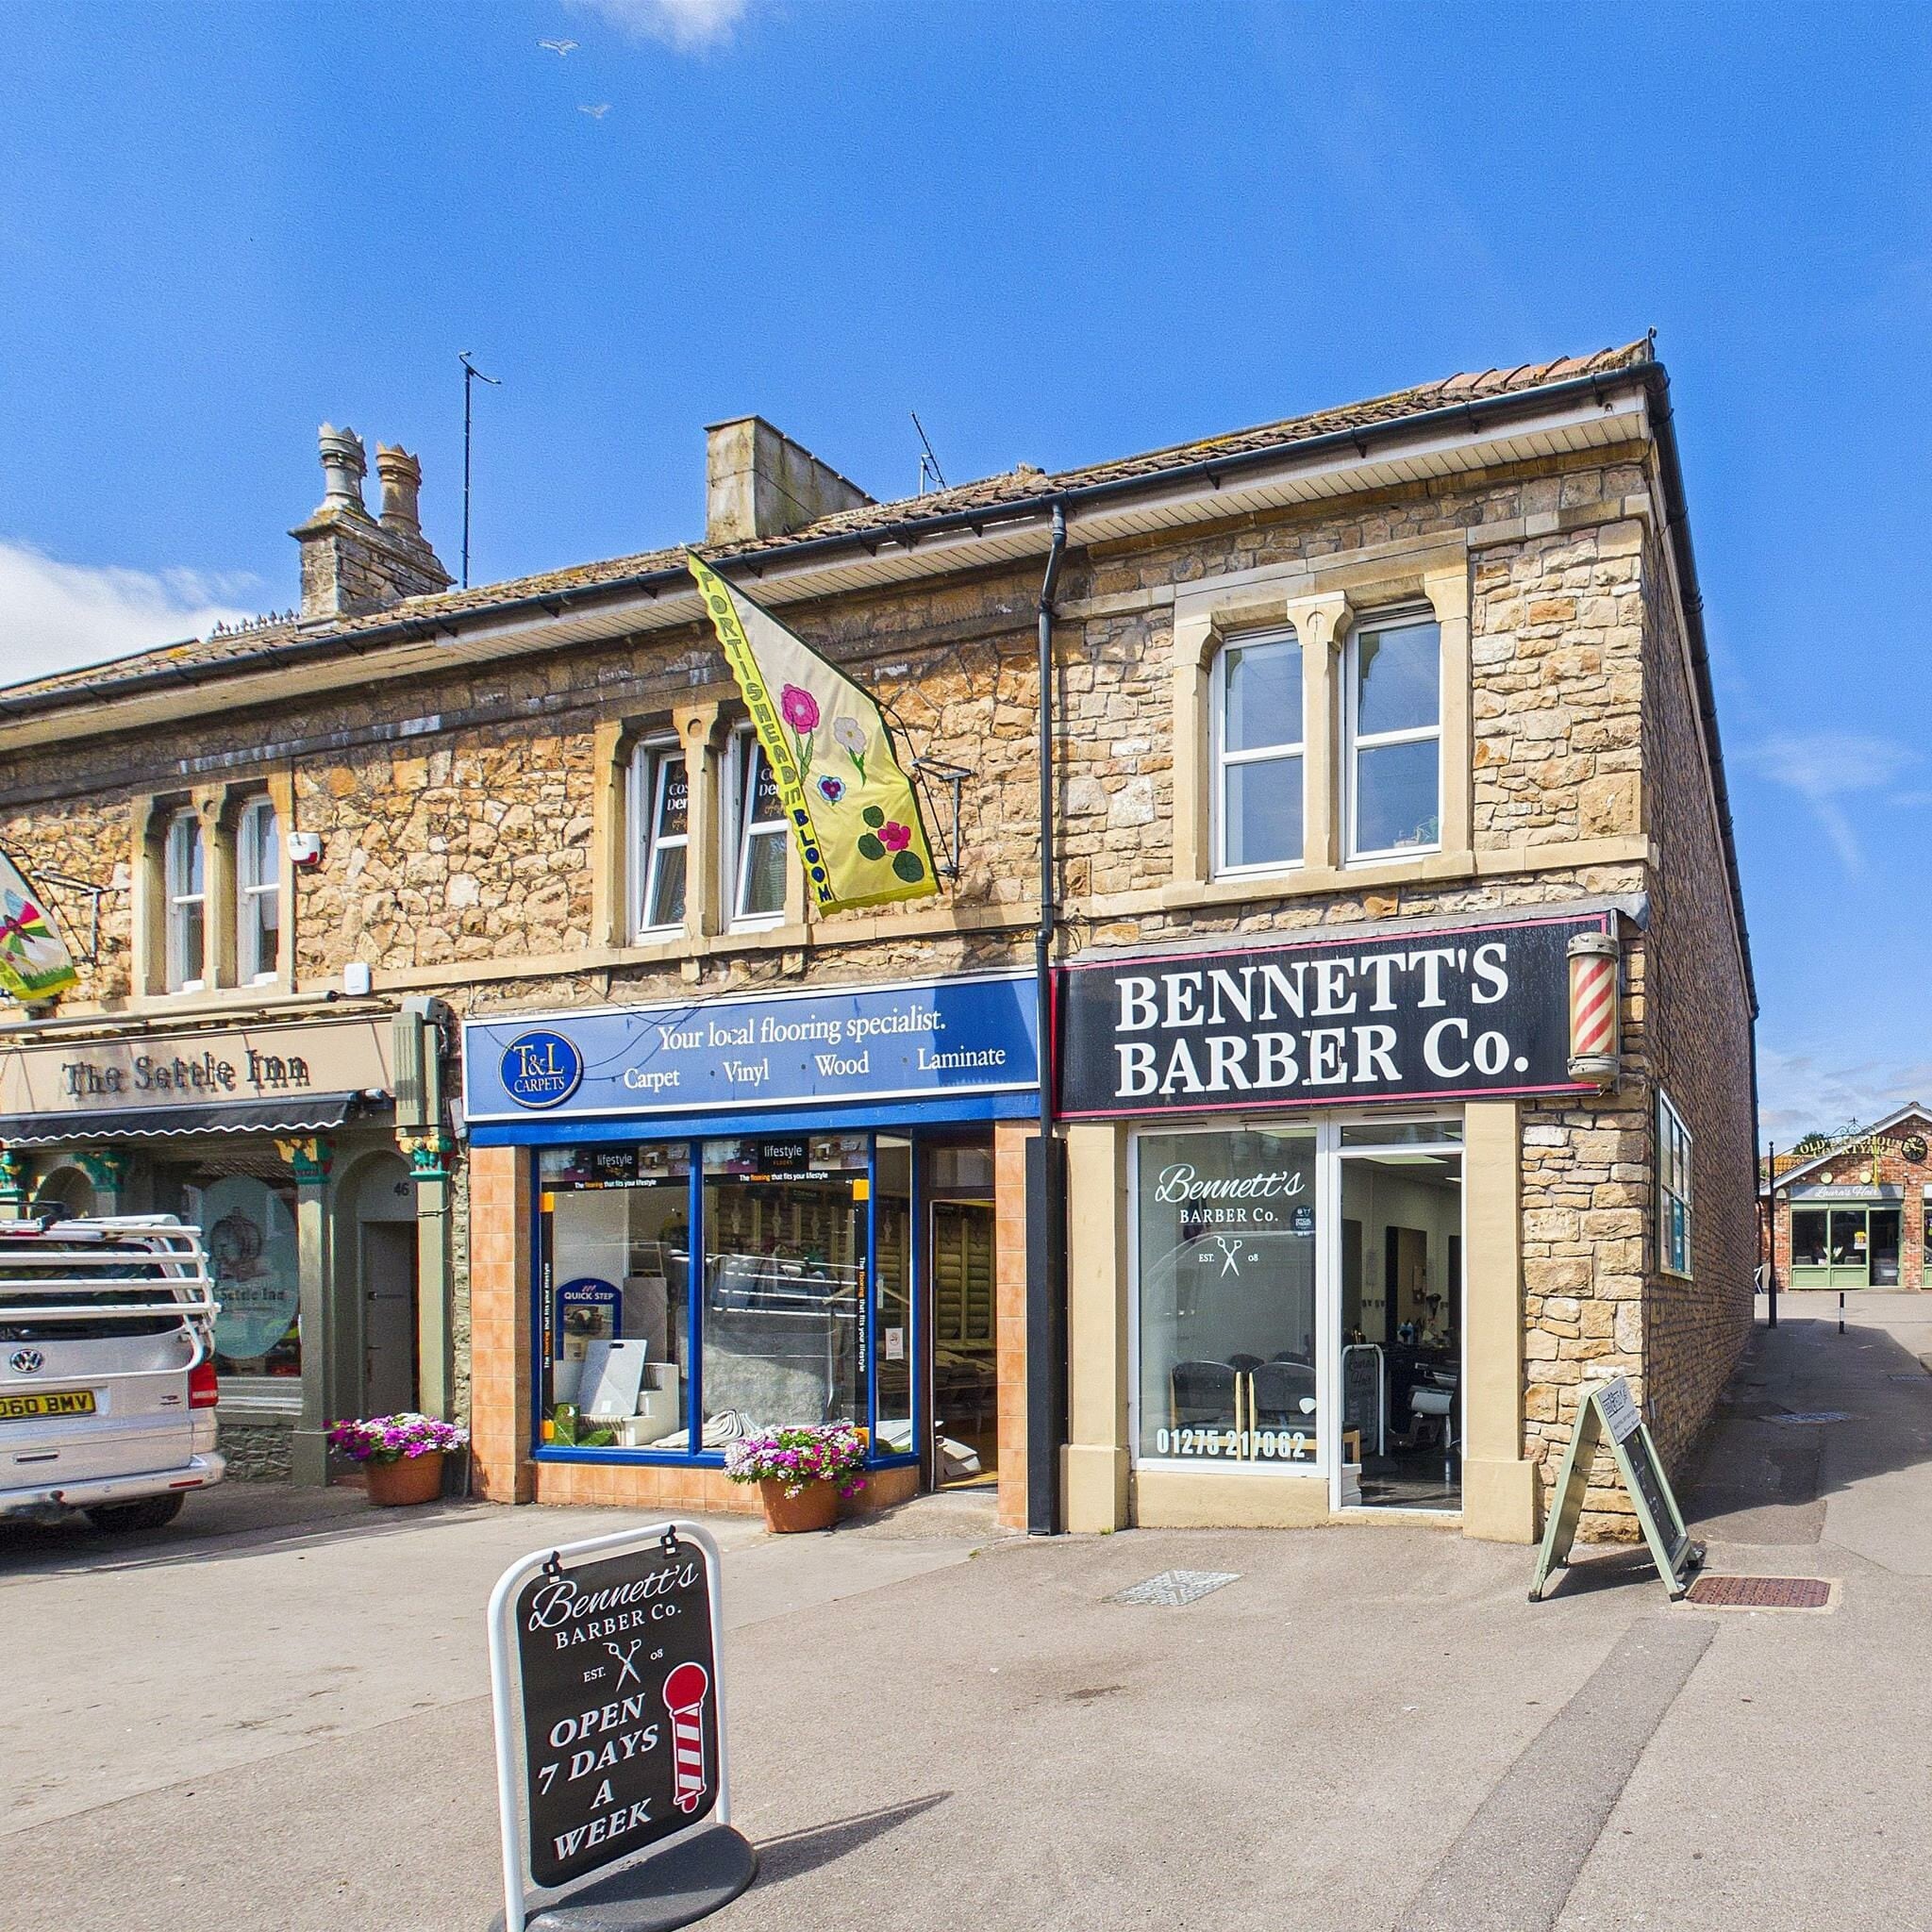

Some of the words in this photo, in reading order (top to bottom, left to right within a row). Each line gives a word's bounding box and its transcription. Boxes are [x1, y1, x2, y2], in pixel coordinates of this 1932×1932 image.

[699, 571, 797, 785] PORTISHEAD
[793, 808, 833, 903] BLOOM
[1115, 943, 1509, 1031] BENNETT'S
[658, 1026, 703, 1050] Your
[708, 1019, 755, 1047] local
[760, 1015, 841, 1044] flooring
[846, 1005, 946, 1042] specialist.
[62, 1060, 123, 1096] The
[134, 1051, 235, 1091] Settle
[244, 1048, 309, 1086] Inn
[624, 1068, 680, 1092] Carpet
[723, 1058, 769, 1086] Vinyl
[815, 1051, 870, 1076] Wood
[917, 1045, 1007, 1071] Laminate
[1115, 1025, 1402, 1097] BARBER
[1424, 1018, 1528, 1078] Co.
[513, 1076, 565, 1093] CARPETS
[597, 1154, 633, 1167] lifestyle
[764, 1145, 803, 1158] lifestyle
[1800, 1140, 1825, 1155] OLD
[393, 1182, 410, 1196] 46
[1156, 1163, 1306, 1203] Bennett's
[1180, 1208, 1247, 1224] BARBER
[1253, 1208, 1278, 1222] Co.
[45, 1395, 87, 1412] BMV
[1157, 1428, 1219, 1456] 01275
[528, 1562, 699, 1633] Bennett's
[556, 1608, 645, 1650] BARBER
[651, 1604, 682, 1620] Co.
[583, 1666, 606, 1683] EST.
[549, 1692, 645, 1748] OPEN
[538, 1765, 557, 1795] 7
[568, 1724, 659, 1783] DAYS
[591, 1779, 614, 1809] A
[553, 1798, 652, 1861] WEEK
